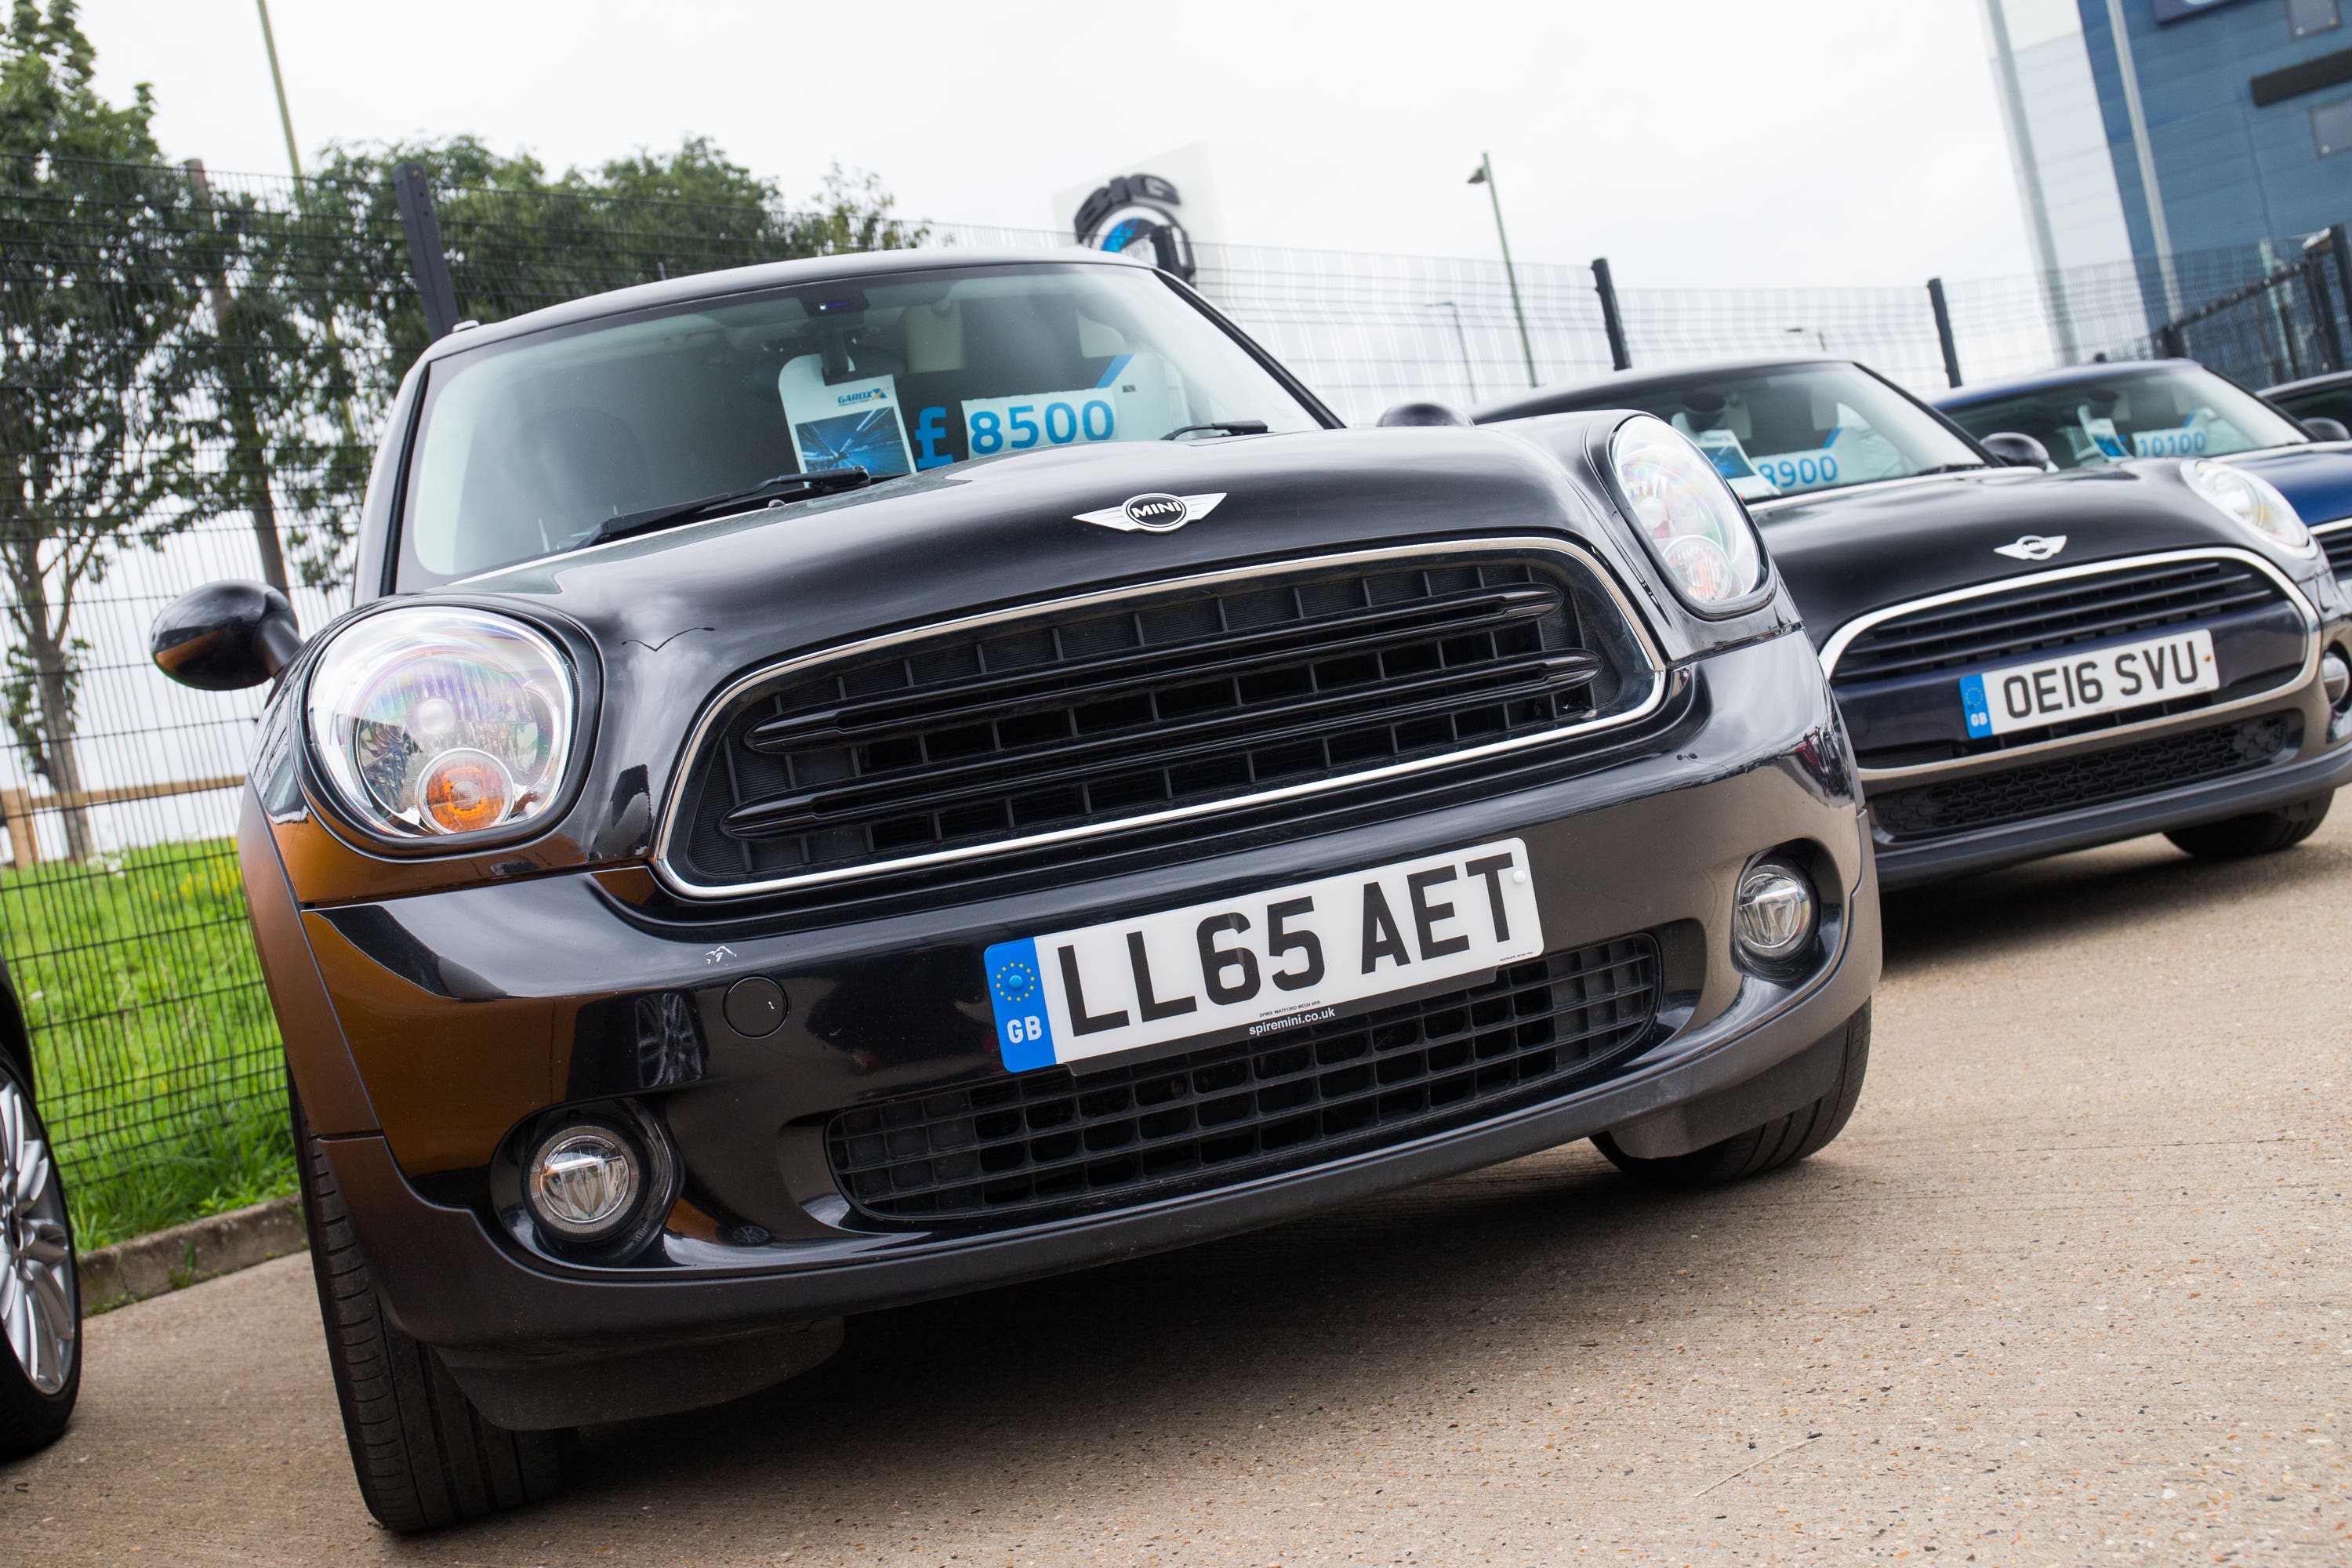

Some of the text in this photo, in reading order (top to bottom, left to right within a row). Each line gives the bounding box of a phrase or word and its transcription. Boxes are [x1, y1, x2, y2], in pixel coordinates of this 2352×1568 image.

[969, 400, 1115, 455] 8500
[2139, 431, 2207, 457] 10100
[1131, 502, 1182, 518] MINI
[2003, 641, 2198, 719] OE16 SVU
[1970, 712, 1987, 727] GB
[1058, 852, 1515, 1037] LL65 AET
[1249, 1007, 1336, 1036] spiremini.co.uk
[1274, 1004, 1298, 1014] WATFORD
[1007, 1015, 1042, 1044] GB
